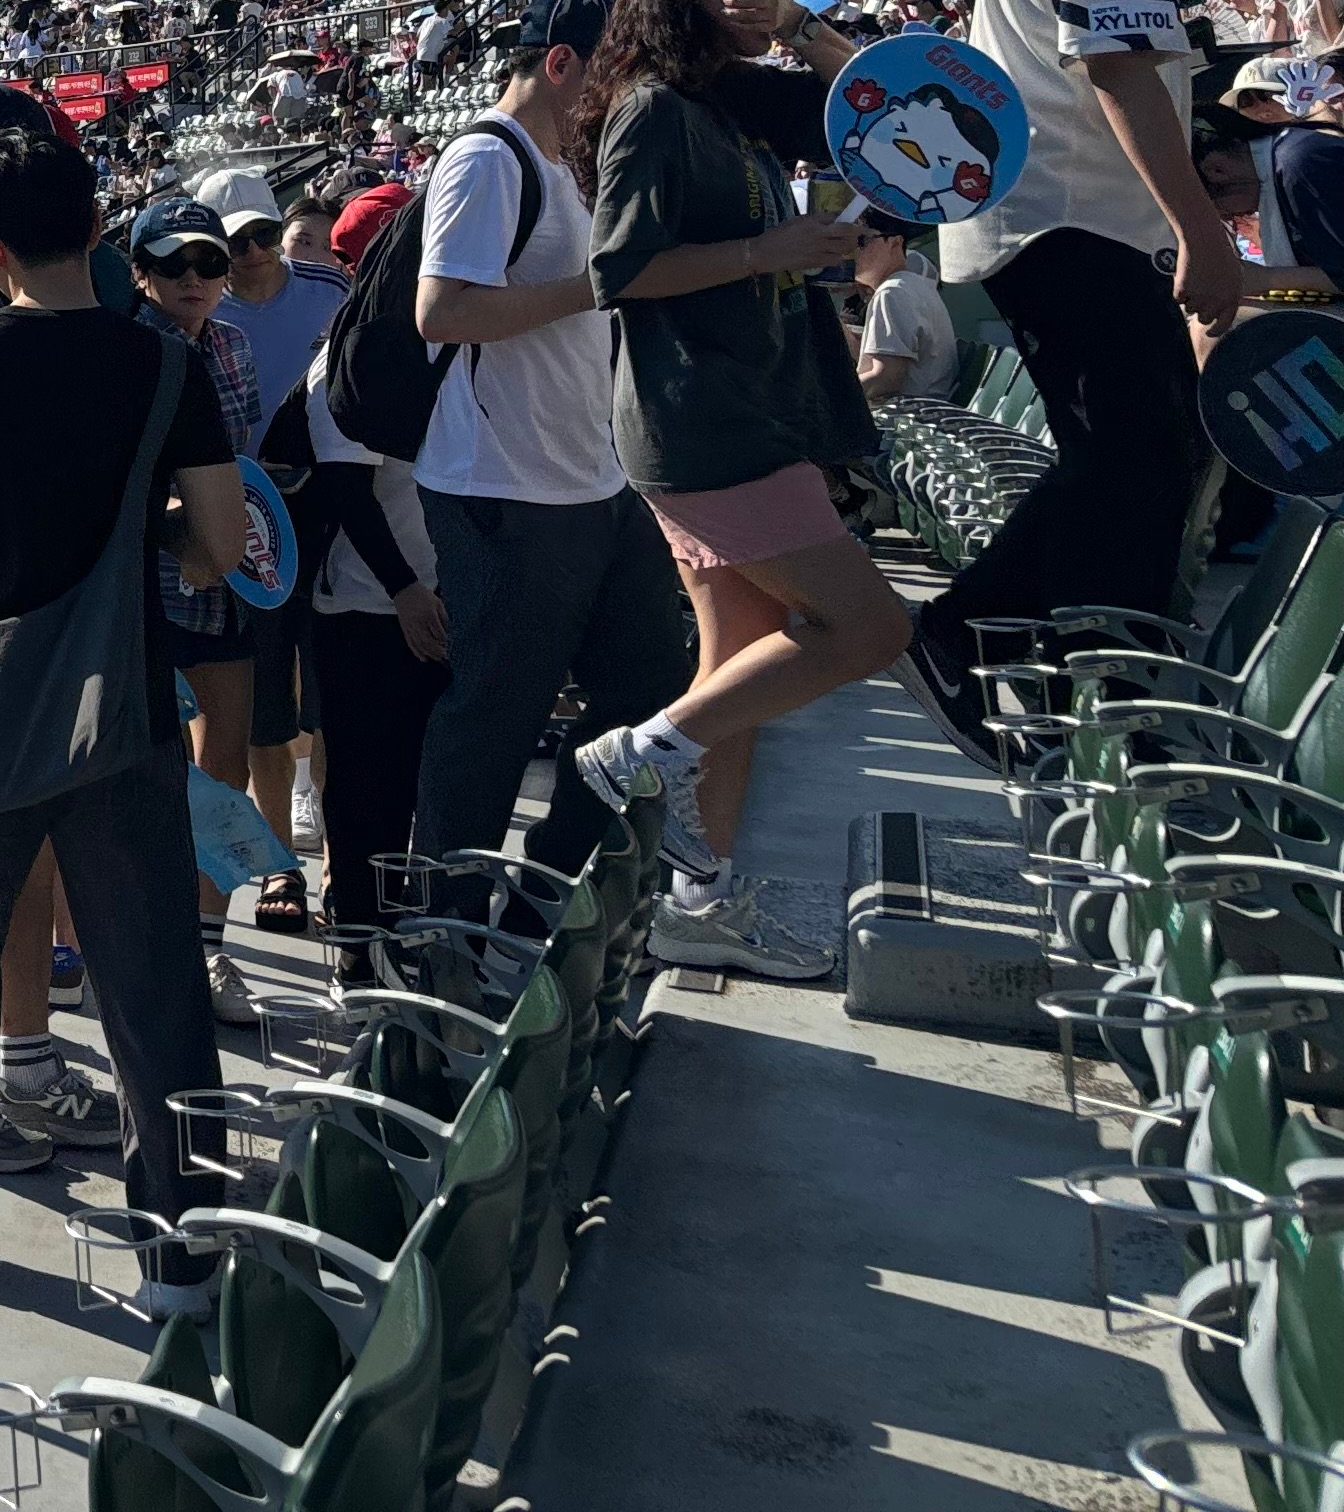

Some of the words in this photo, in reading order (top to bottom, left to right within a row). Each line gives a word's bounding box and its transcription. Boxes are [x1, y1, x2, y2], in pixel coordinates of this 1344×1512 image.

[1093, 11, 1175, 32] XYLITOL
[925, 43, 1011, 110] Giants
[1297, 86, 1317, 102] G
